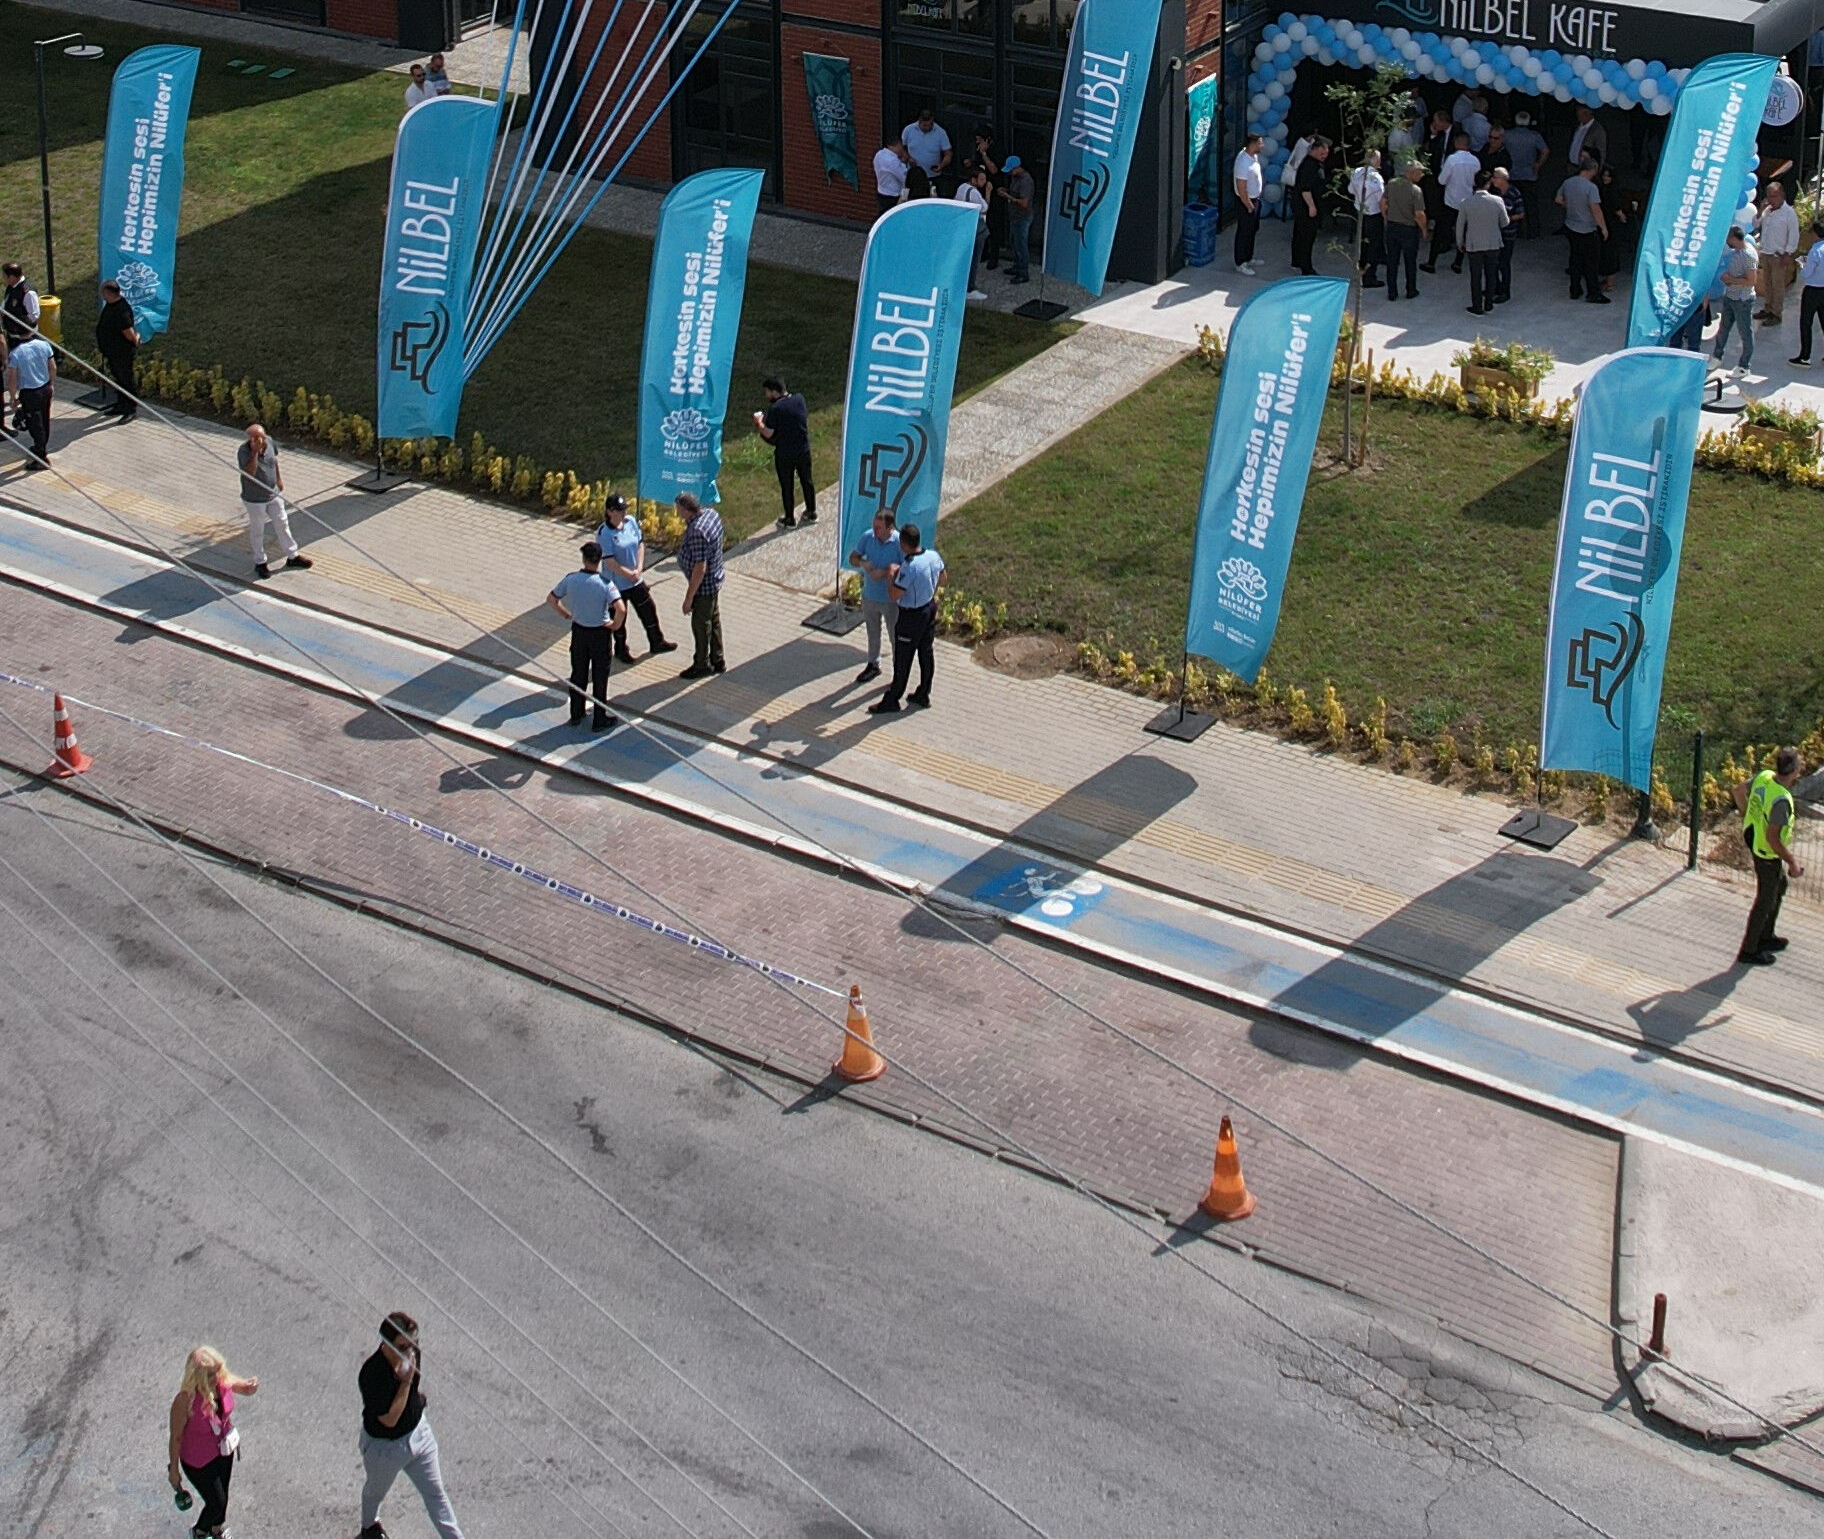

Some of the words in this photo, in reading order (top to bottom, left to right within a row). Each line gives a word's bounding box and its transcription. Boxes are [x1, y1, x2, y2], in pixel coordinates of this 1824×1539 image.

[1549, 3, 1619, 53] KAFE
[120, 163, 144, 252] Herkesin
[134, 118, 150, 159] sesi
[137, 154, 163, 255] Hepimizin
[1664, 174, 1702, 266] Herkesin
[1692, 128, 1714, 171] sesi
[1681, 166, 1723, 267] Hepimizin
[669, 300, 696, 396] Herkesin
[683, 252, 703, 297] sesi
[688, 290, 717, 395] Hepimizin
[1230, 422, 1266, 542] Herkesin
[1254, 372, 1277, 424] sesi
[1248, 420, 1290, 549] Hepimizin
